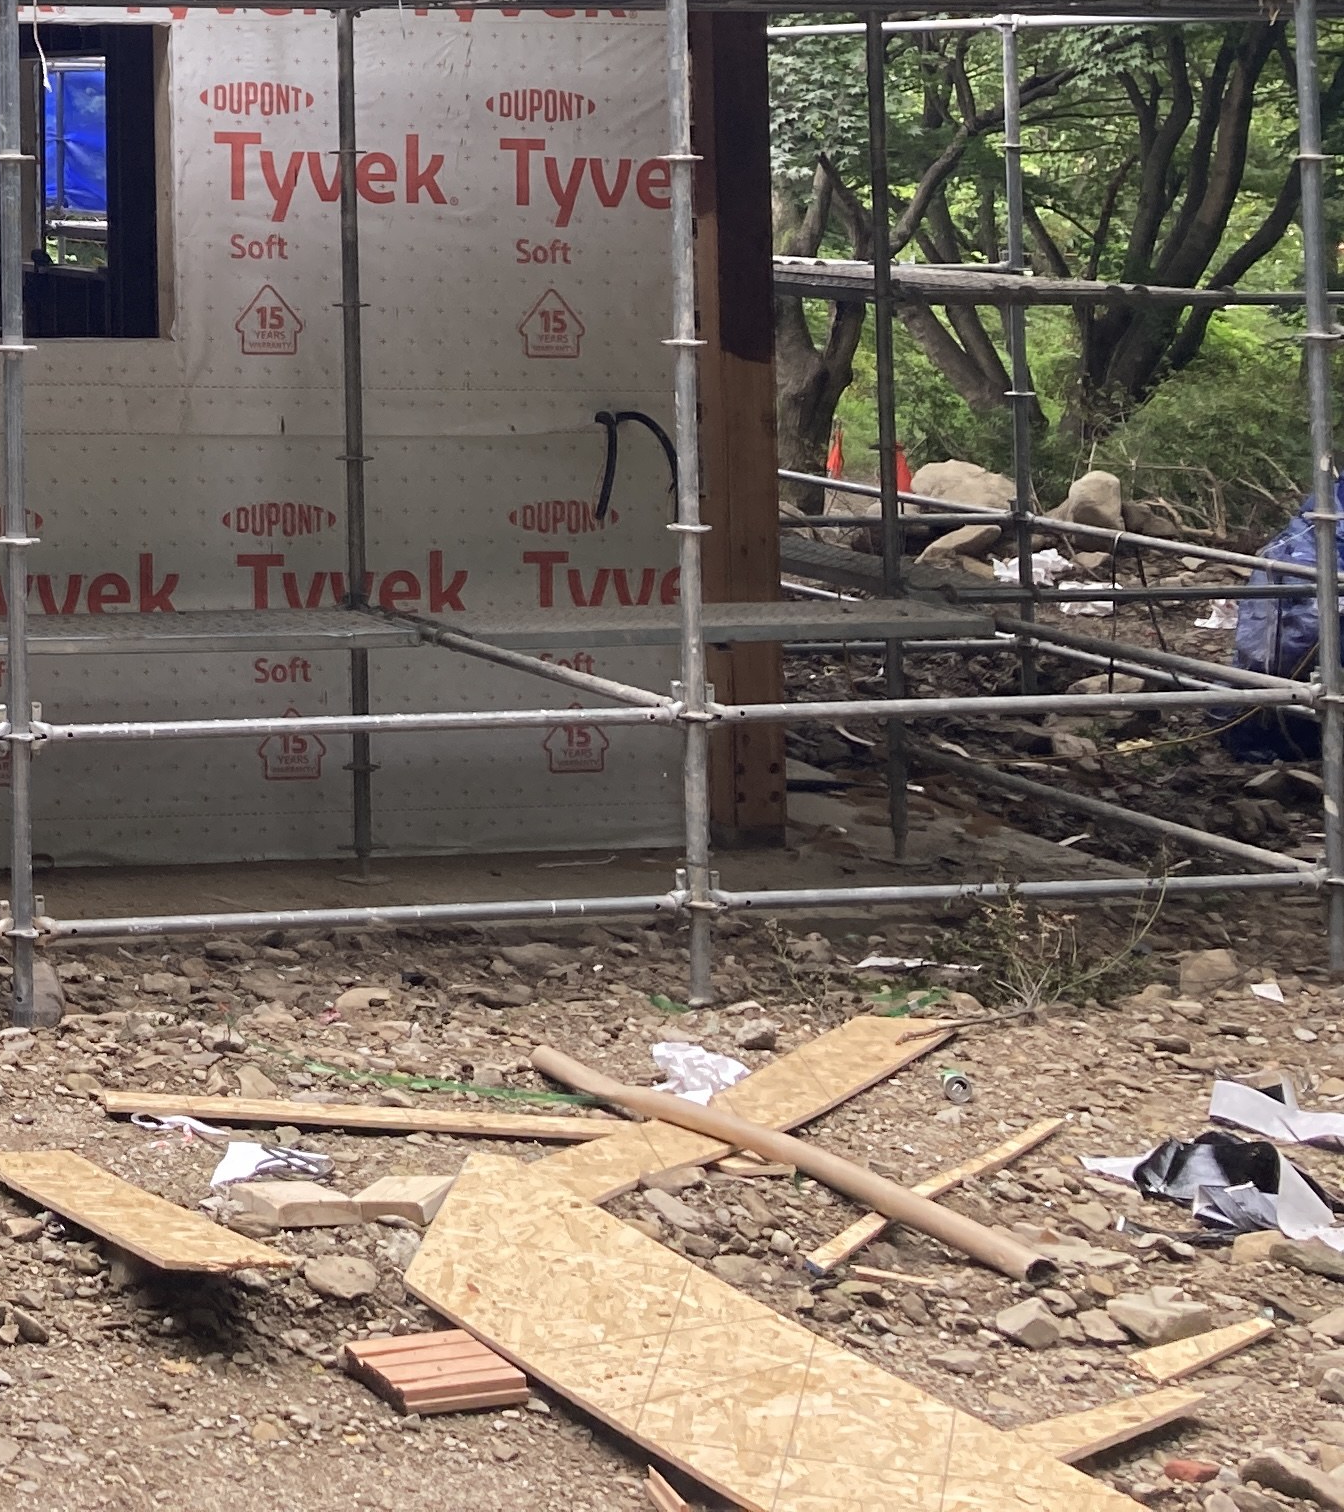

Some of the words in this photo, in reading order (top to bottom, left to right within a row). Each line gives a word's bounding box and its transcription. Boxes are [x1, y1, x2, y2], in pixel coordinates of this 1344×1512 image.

[214, 81, 302, 116] DUPONT
[499, 89, 583, 123] DUPONT
[214, 132, 445, 223] Tyvek
[500, 138, 671, 228] Tyve
[230, 233, 288, 260] Soft
[516, 238, 572, 265] Soft
[255, 306, 284, 329] 15
[539, 310, 566, 333] 15
[254, 330, 286, 340] YEARS
[538, 333, 569, 344] YEARS
[236, 502, 325, 537] DUPONT
[255, 658, 312, 684] Soft
